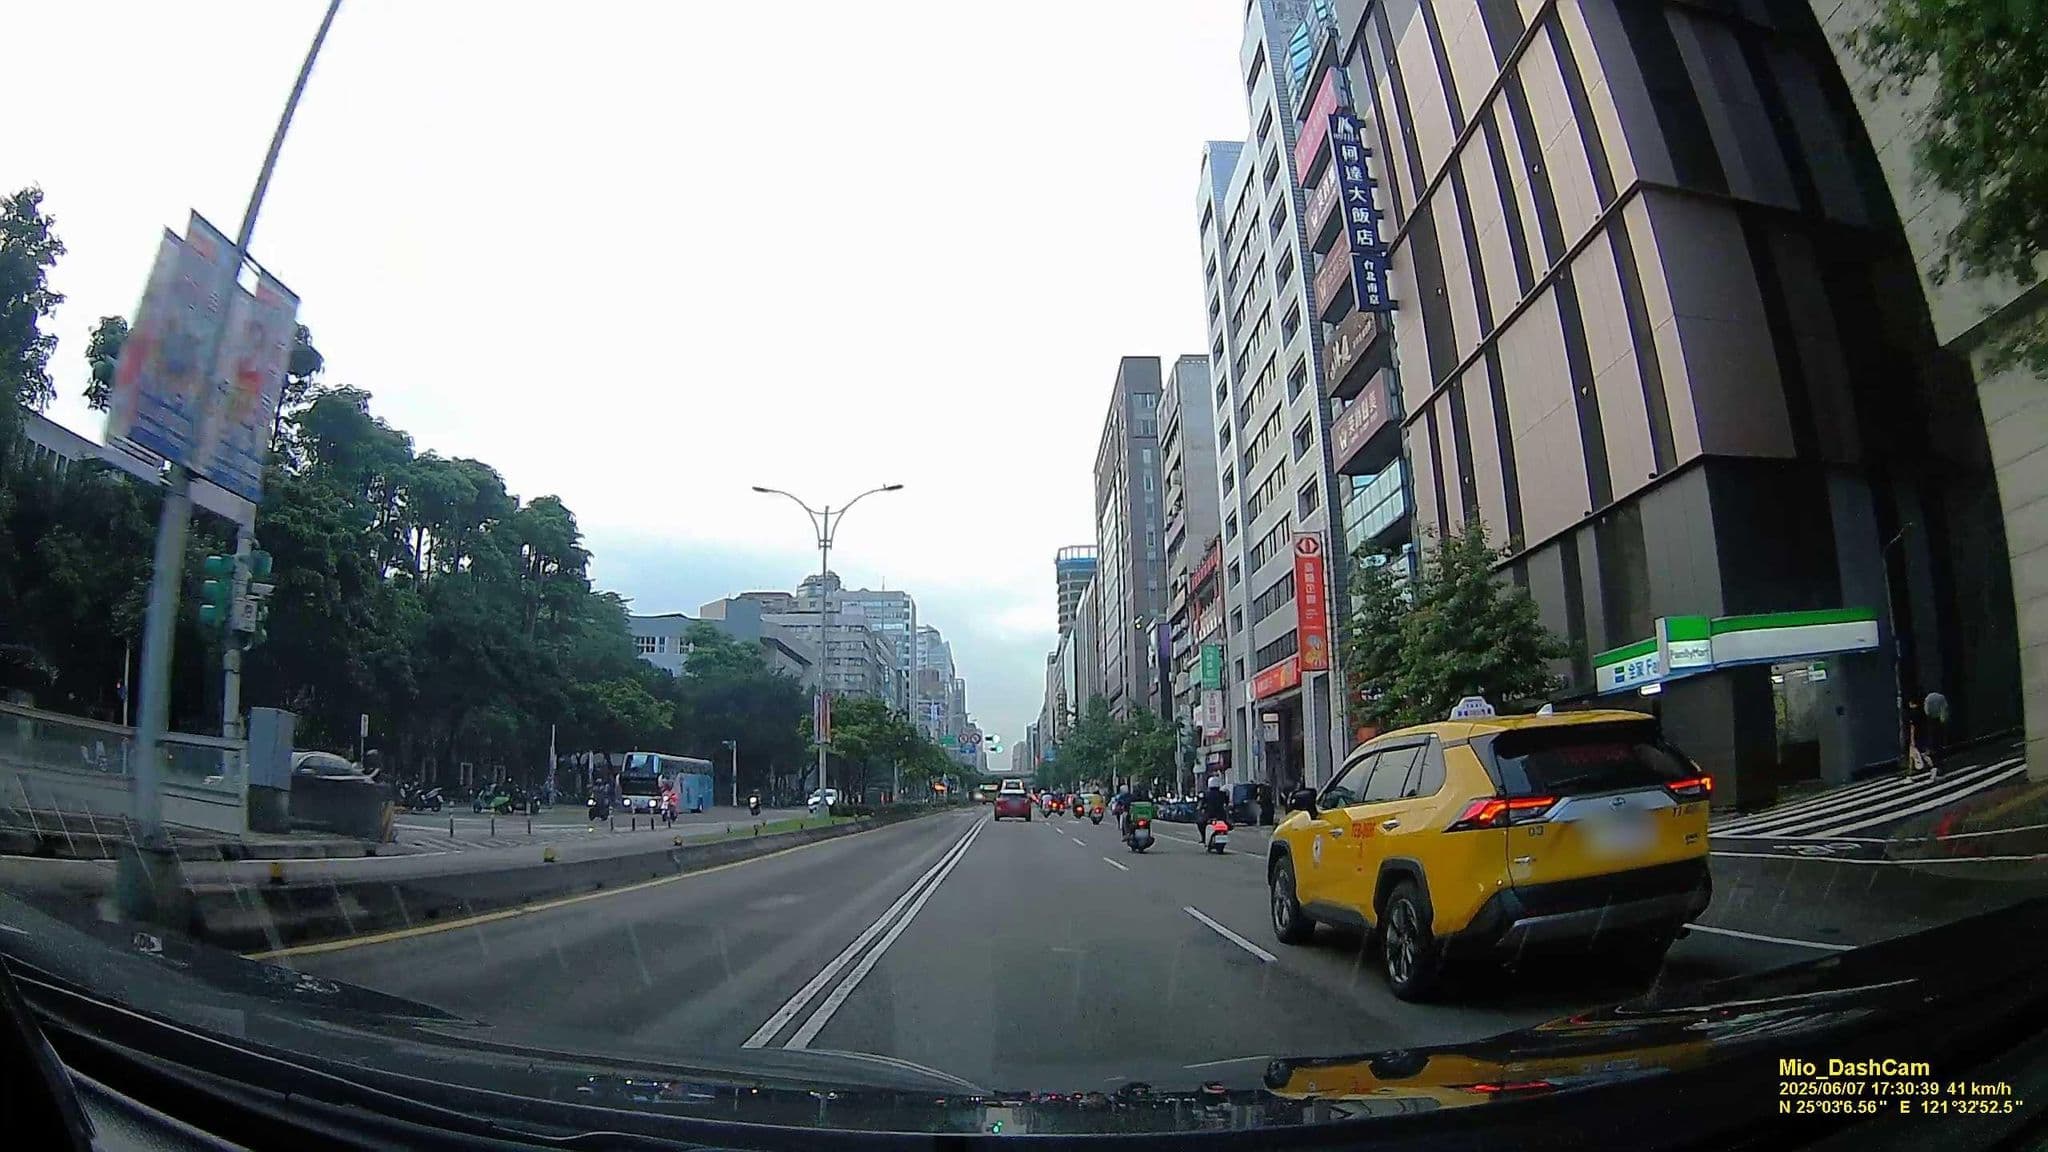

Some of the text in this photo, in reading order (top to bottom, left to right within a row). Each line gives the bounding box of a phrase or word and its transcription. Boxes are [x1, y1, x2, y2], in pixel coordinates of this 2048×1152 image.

[1341, 144, 1375, 247] 柯達大飯店
[1363, 259, 1380, 305] 台北南京
[1669, 648, 1710, 660] FamilyMart
